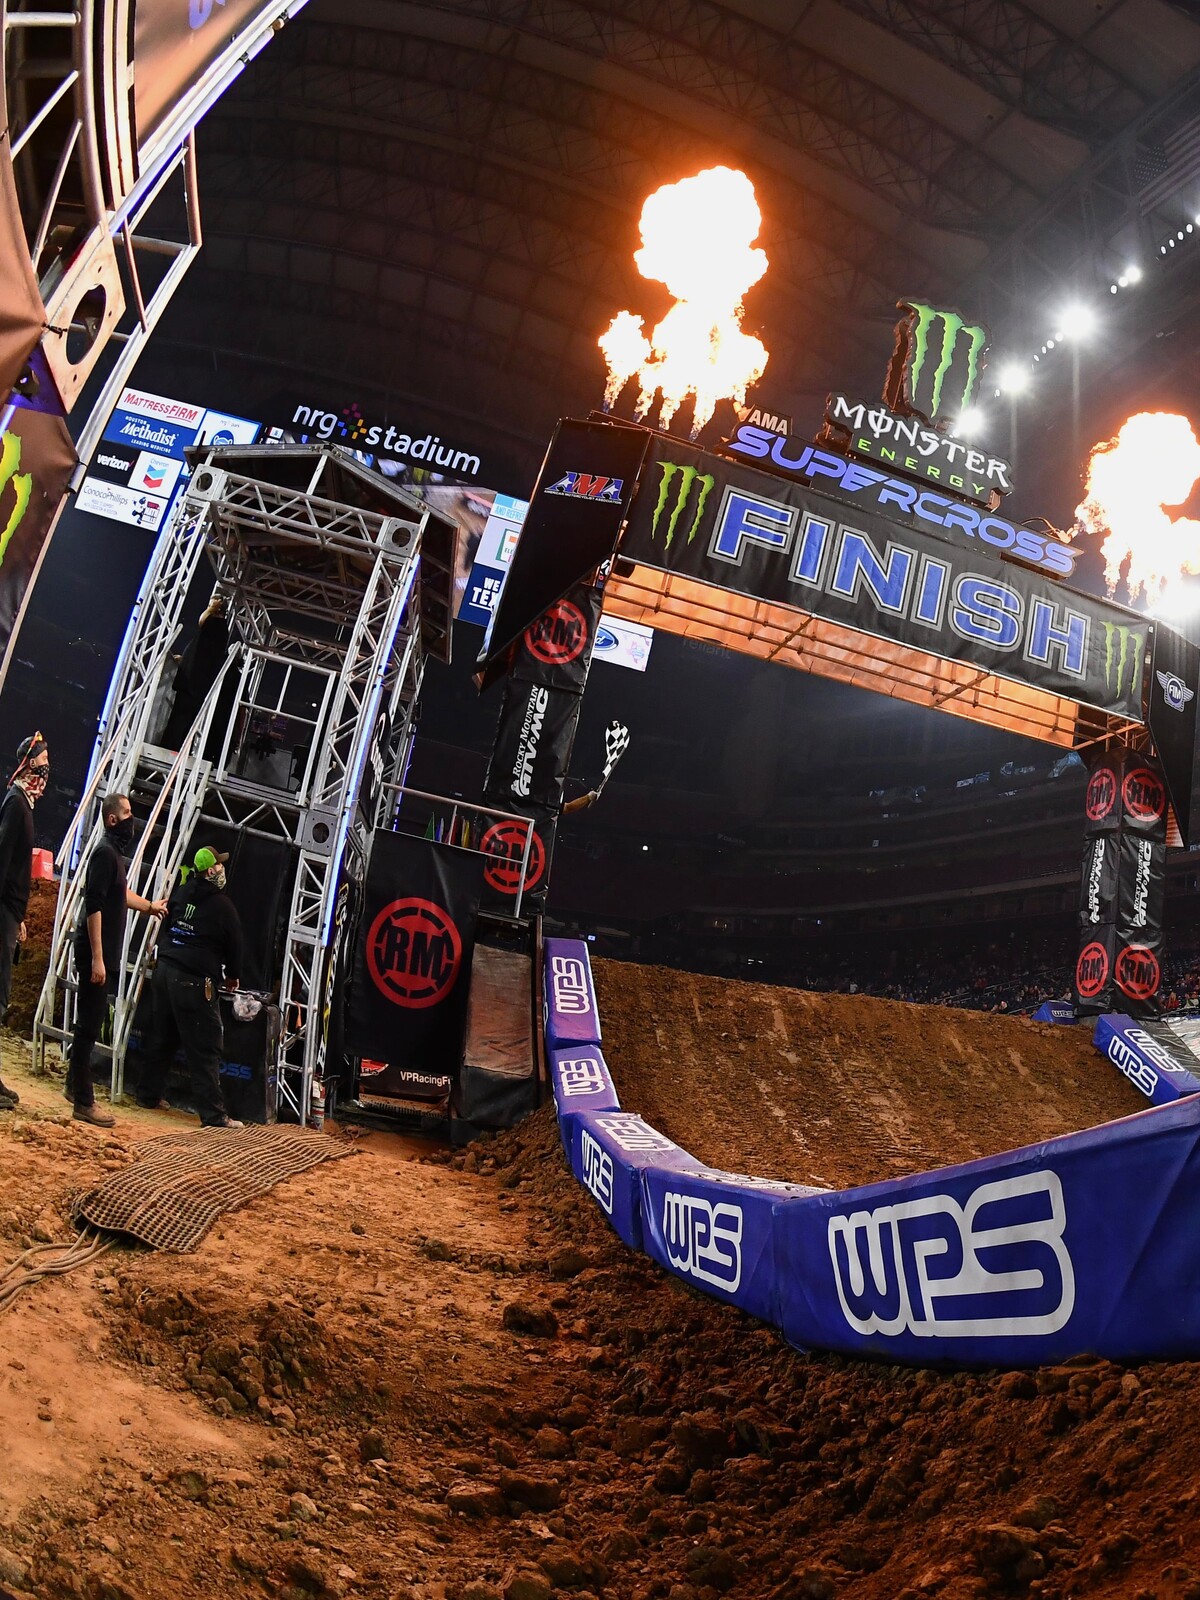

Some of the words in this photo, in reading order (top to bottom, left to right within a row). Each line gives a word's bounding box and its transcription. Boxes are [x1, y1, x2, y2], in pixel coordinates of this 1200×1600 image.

[119, 422, 177, 447] Methodist
[292, 405, 338, 439] nrg
[365, 426, 481, 475] stadium
[748, 411, 789, 435] AMA
[97, 454, 130, 471] verizon
[544, 471, 624, 501] AMA
[858, 438, 985, 496] ENERGY
[83, 485, 128, 506] ConocoPhillips
[728, 425, 1084, 574] SUPERCROSS
[484, 578, 500, 592] WE
[706, 484, 1091, 681] FINISH
[513, 742, 524, 778] ROCKY
[519, 685, 539, 743] MOUNTAIN
[551, 956, 590, 1014] WPS
[559, 1058, 606, 1097] WPS
[1108, 1036, 1158, 1097] WPS
[1123, 1028, 1184, 1072] WPS
[595, 1119, 676, 1151] WPS
[581, 1129, 614, 1215] WPS
[663, 1191, 742, 1294] WPS
[829, 1169, 1076, 1338] WPS
